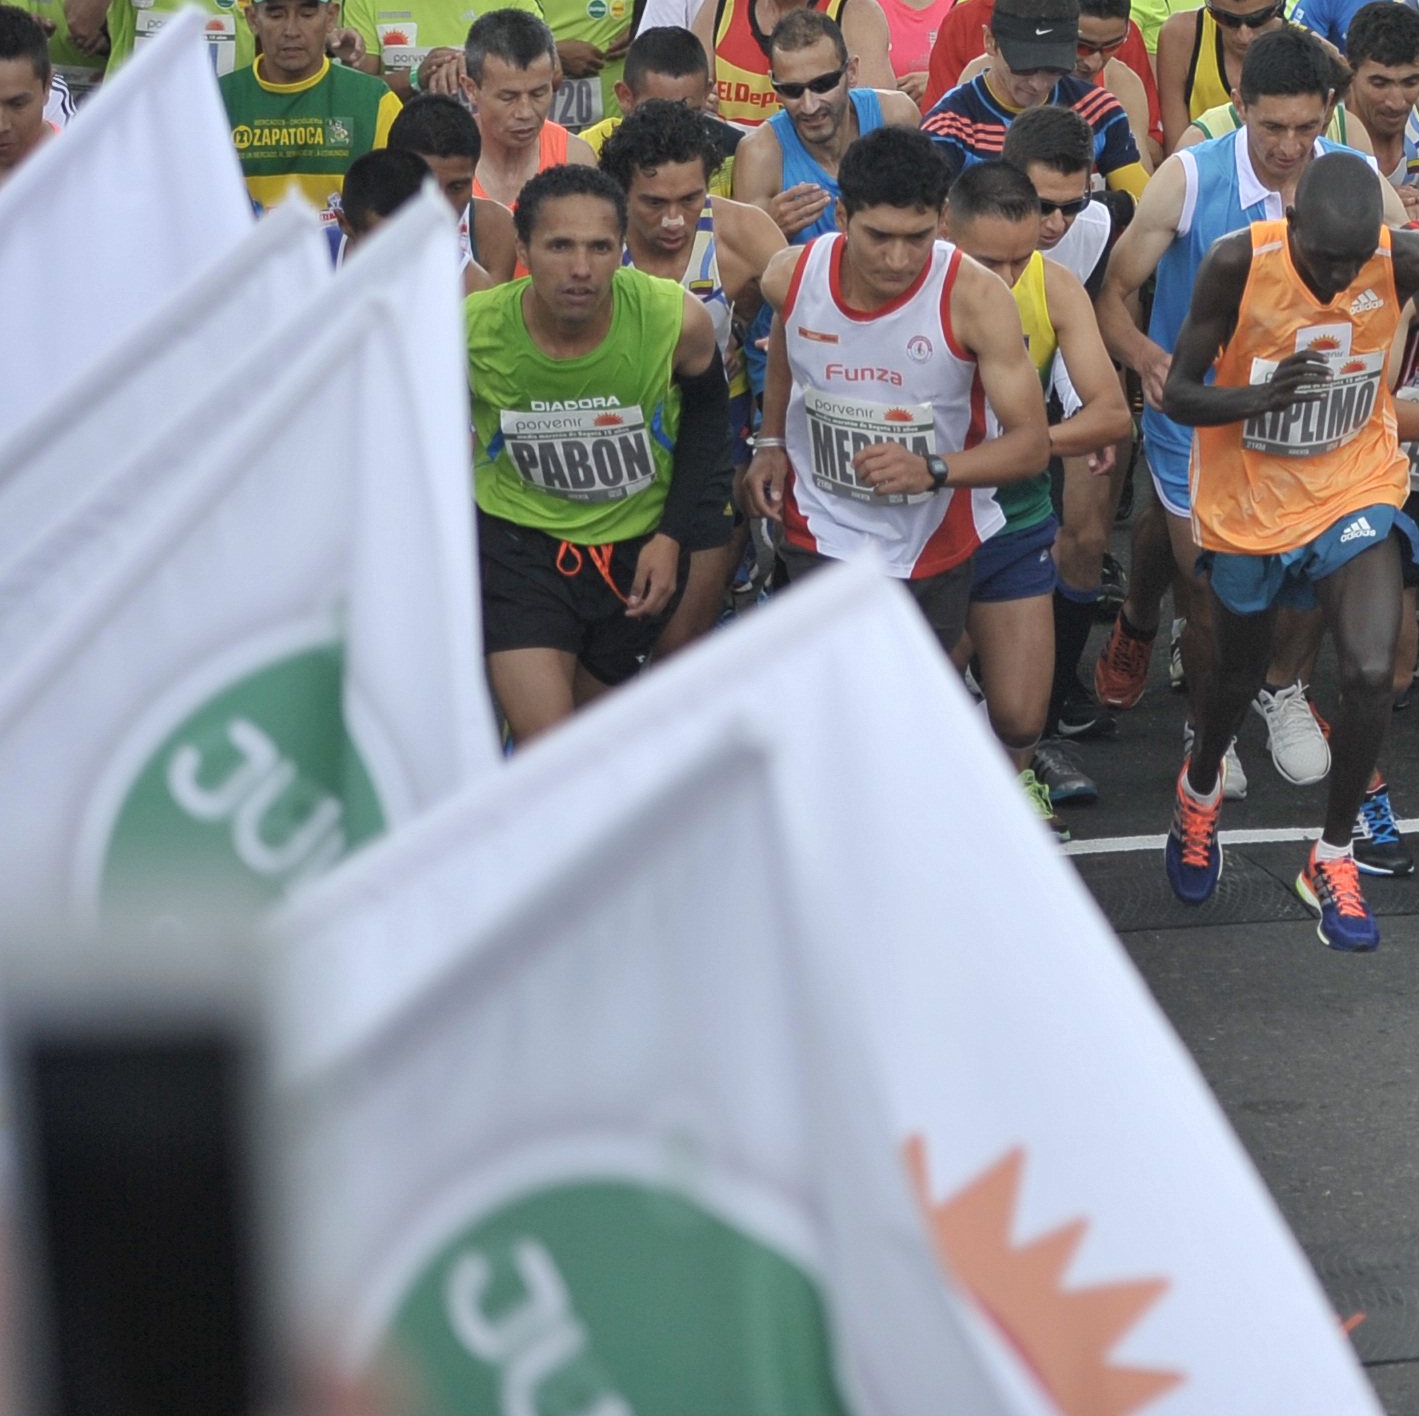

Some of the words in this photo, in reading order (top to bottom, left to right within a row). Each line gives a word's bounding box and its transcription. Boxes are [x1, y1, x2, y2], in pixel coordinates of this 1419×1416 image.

[253, 128, 323, 146] ZAPATOCA
[1349, 299, 1384, 315] adidas
[825, 364, 903, 386] Funza
[531, 395, 621, 412] DIADORA
[815, 398, 874, 419] porvenir
[515, 417, 583, 433] porvenir
[510, 431, 654, 489] PABON
[1340, 529, 1377, 543] adidas
